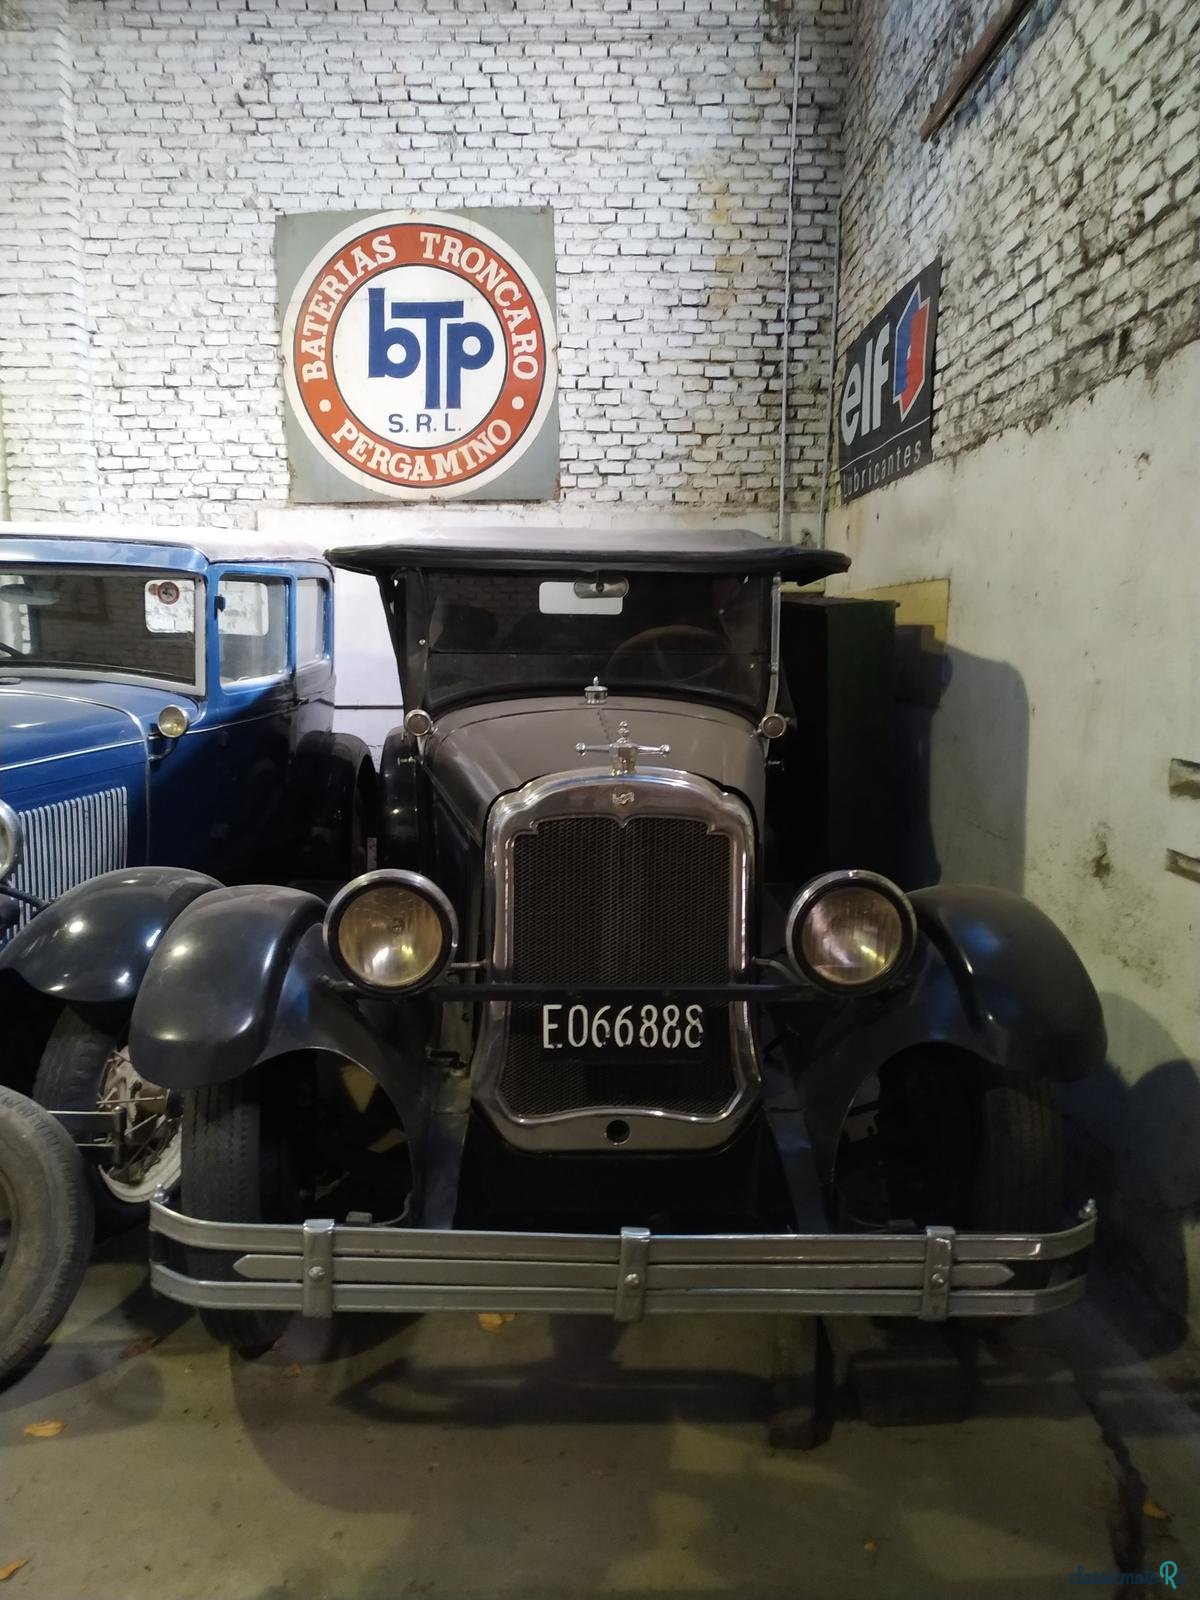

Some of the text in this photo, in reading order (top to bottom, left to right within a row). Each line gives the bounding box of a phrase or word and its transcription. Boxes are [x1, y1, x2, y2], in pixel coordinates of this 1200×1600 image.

[301, 231, 539, 384] BATERIAS TRONCARO
[840, 322, 890, 446] elf
[331, 419, 512, 481] PERGAMINO
[543, 1004, 704, 1049] E066888
